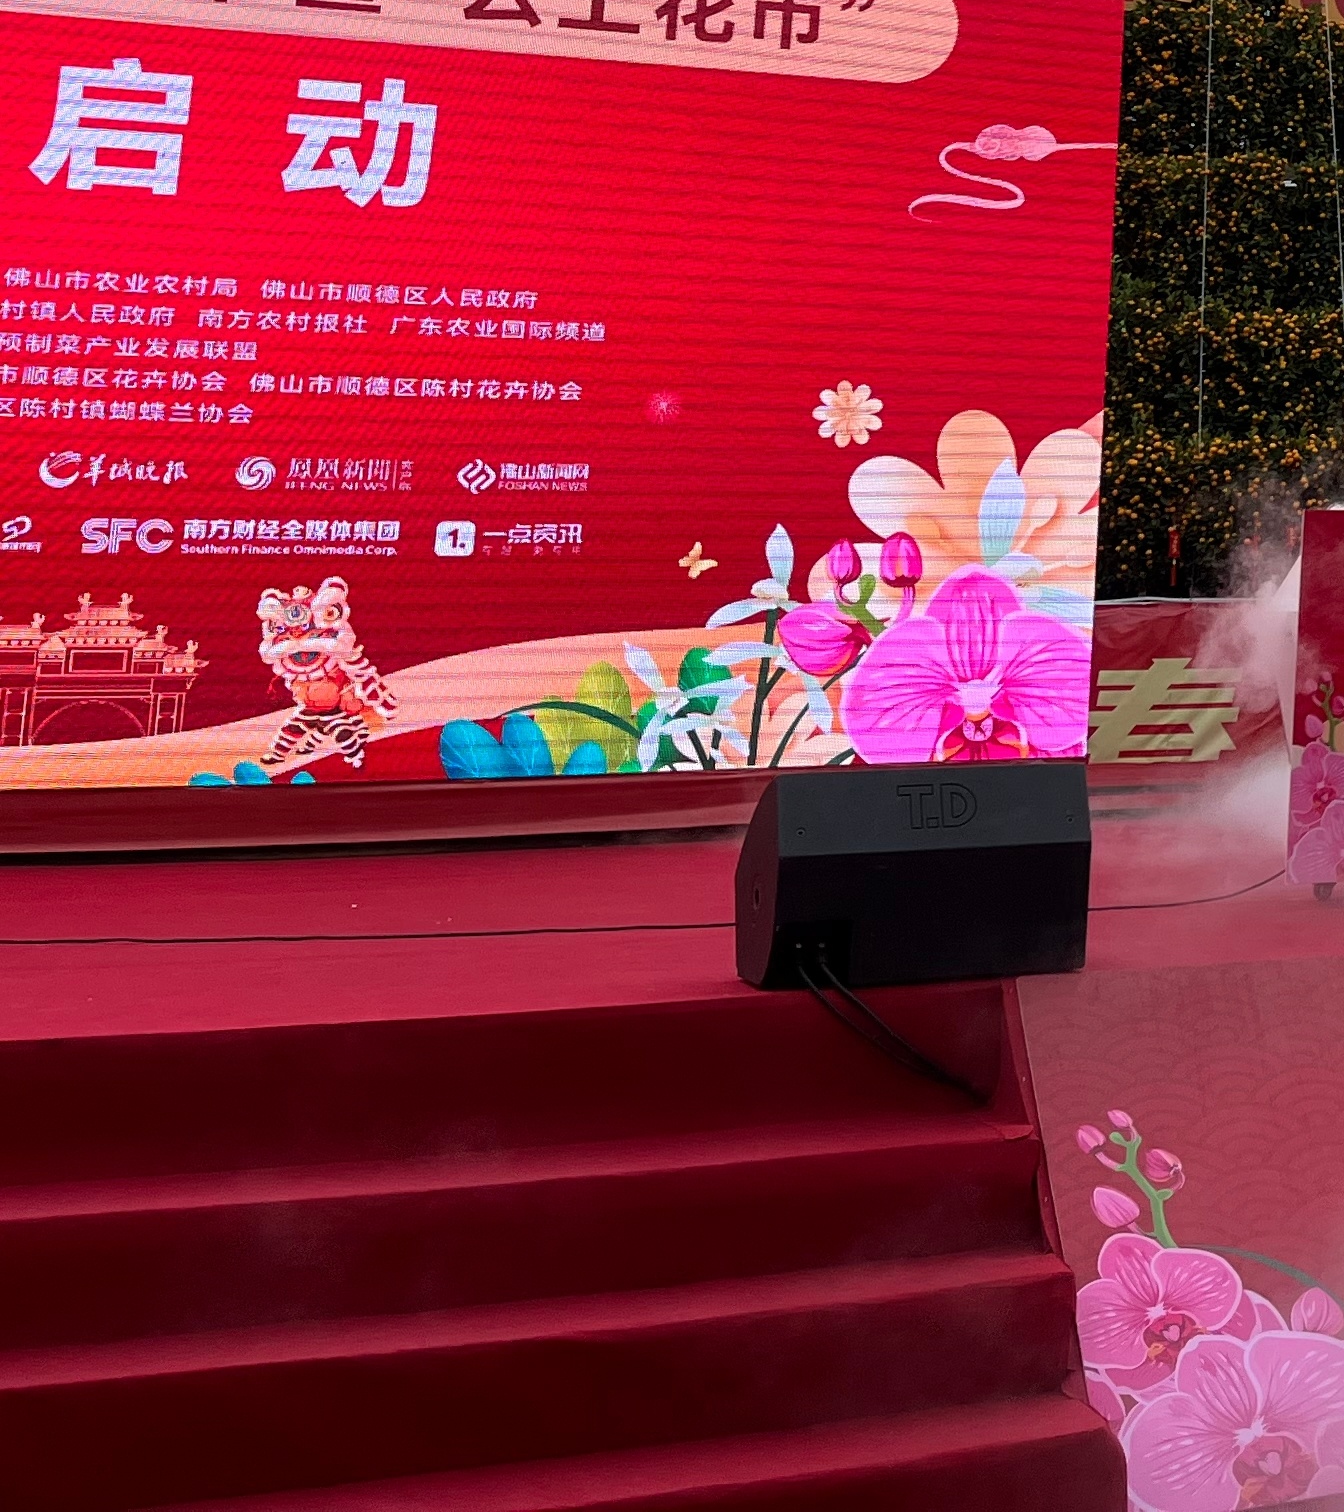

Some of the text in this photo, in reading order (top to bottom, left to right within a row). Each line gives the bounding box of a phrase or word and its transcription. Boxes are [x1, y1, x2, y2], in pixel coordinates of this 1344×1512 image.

[28, 58, 438, 208] 启动
[4, 267, 538, 310] 佛山市农业农村局 佛山市顺德区人民政府
[198, 307, 368, 335] 南方农村报社
[390, 315, 606, 342] 广东农业国际频道
[249, 372, 583, 401] 佛山市顺德区陈村花卉协会
[83, 453, 188, 487] 羊城晚报
[498, 481, 588, 492] FOSHAN NEWS
[80, 517, 174, 554] SFC
[183, 519, 401, 542] 南方财经全媒体集团
[482, 523, 583, 544] 一点资讯
[181, 543, 239, 555] Southern
[241, 544, 290, 555] Finance
[1089, 657, 1243, 765] 春
